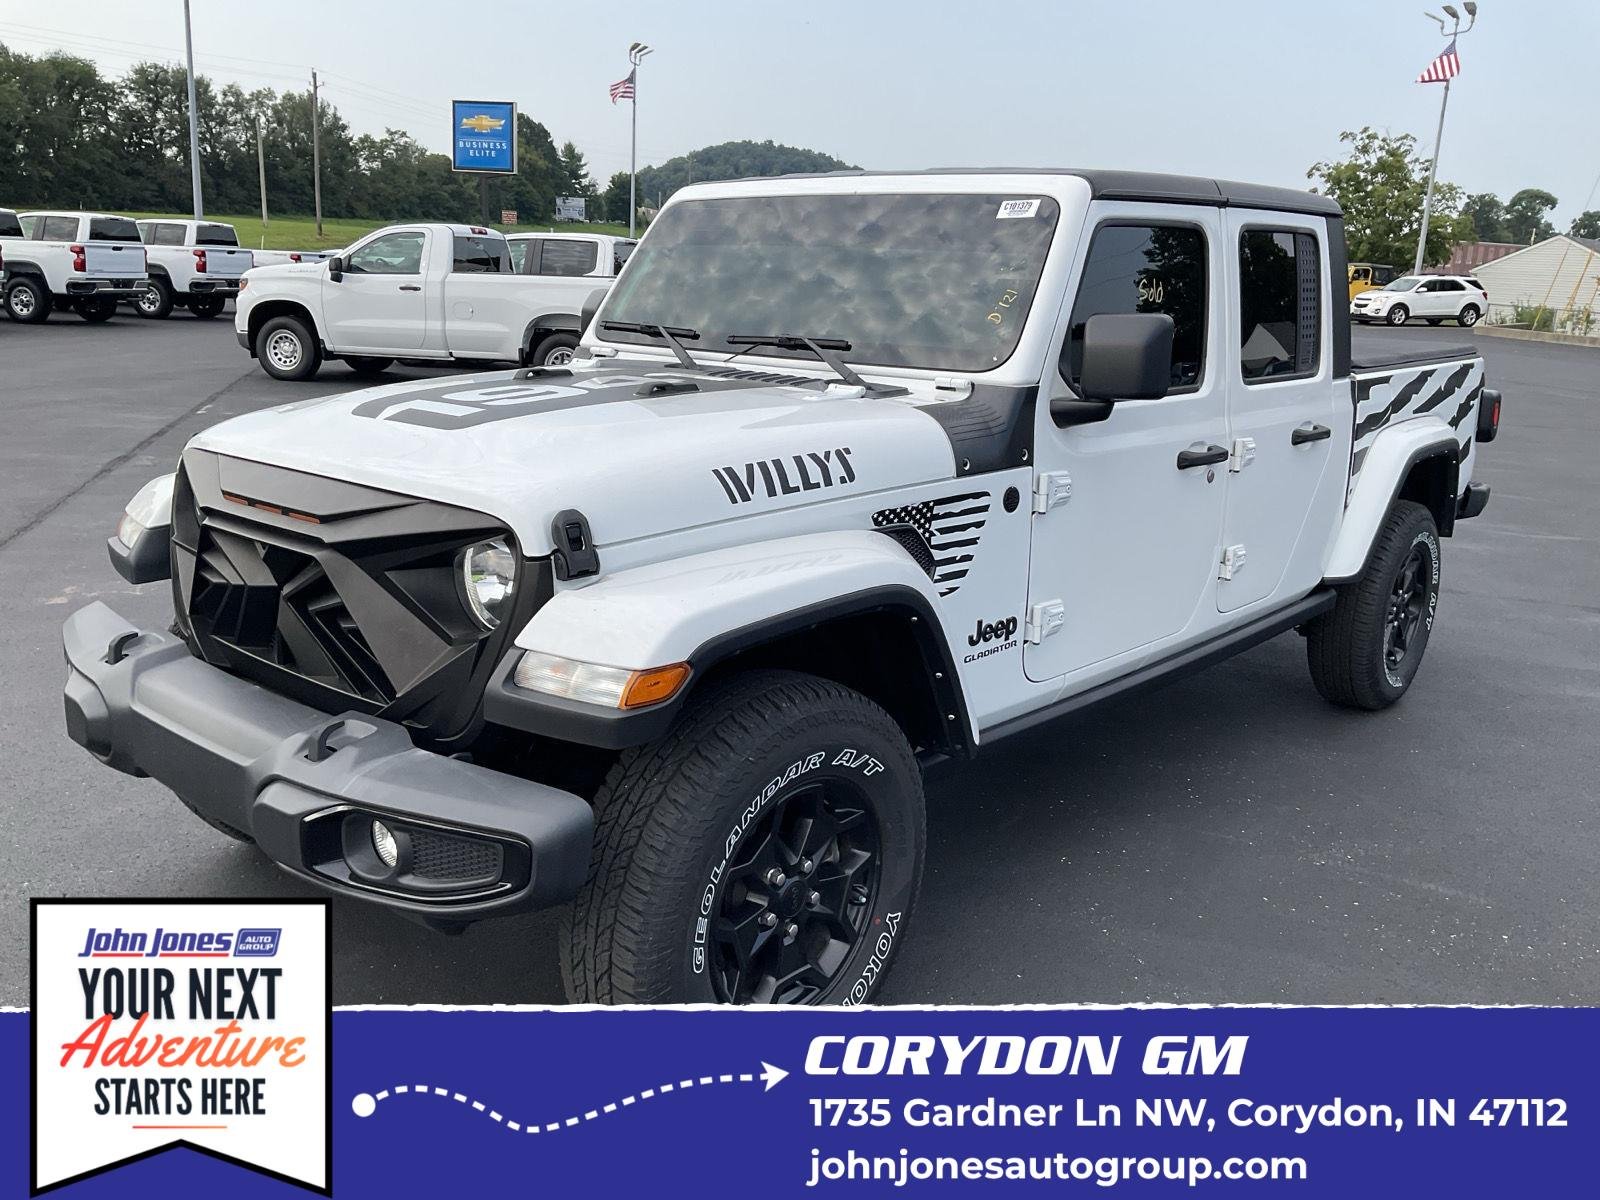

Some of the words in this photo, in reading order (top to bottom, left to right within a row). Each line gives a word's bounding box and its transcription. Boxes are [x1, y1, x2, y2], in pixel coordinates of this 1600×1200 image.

[459, 141, 507, 149] BUSINESS
[469, 149, 496, 157] ELITE
[711, 446, 857, 505] WILLYS
[967, 616, 1018, 647] Jeep
[963, 639, 1018, 664] GLADIATOR
[692, 751, 825, 974] GEOLANDAR
[831, 748, 885, 777] A/T
[842, 911, 902, 1006] YOKO
